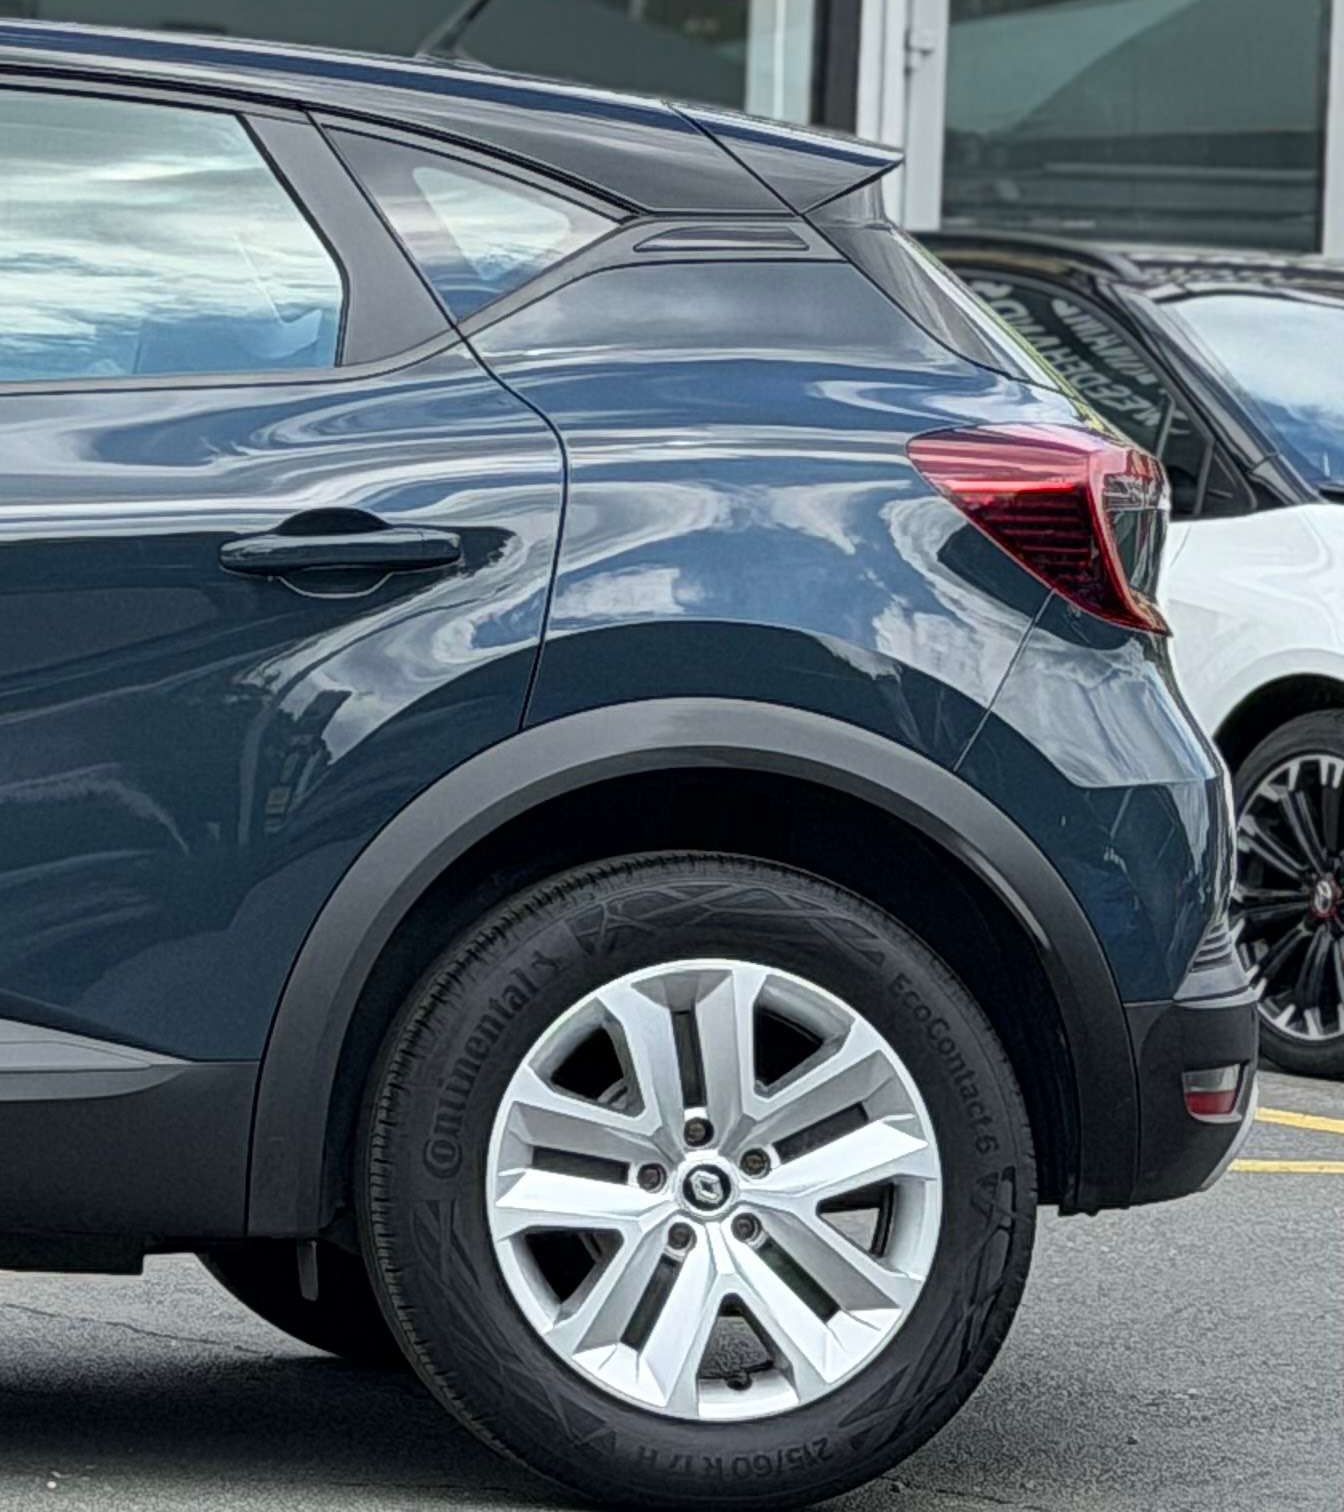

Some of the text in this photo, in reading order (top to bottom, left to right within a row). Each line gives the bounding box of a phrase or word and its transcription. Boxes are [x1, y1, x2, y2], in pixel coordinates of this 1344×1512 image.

[422, 967, 538, 1180] Continental
[890, 971, 1000, 1156] EcoContact 6
